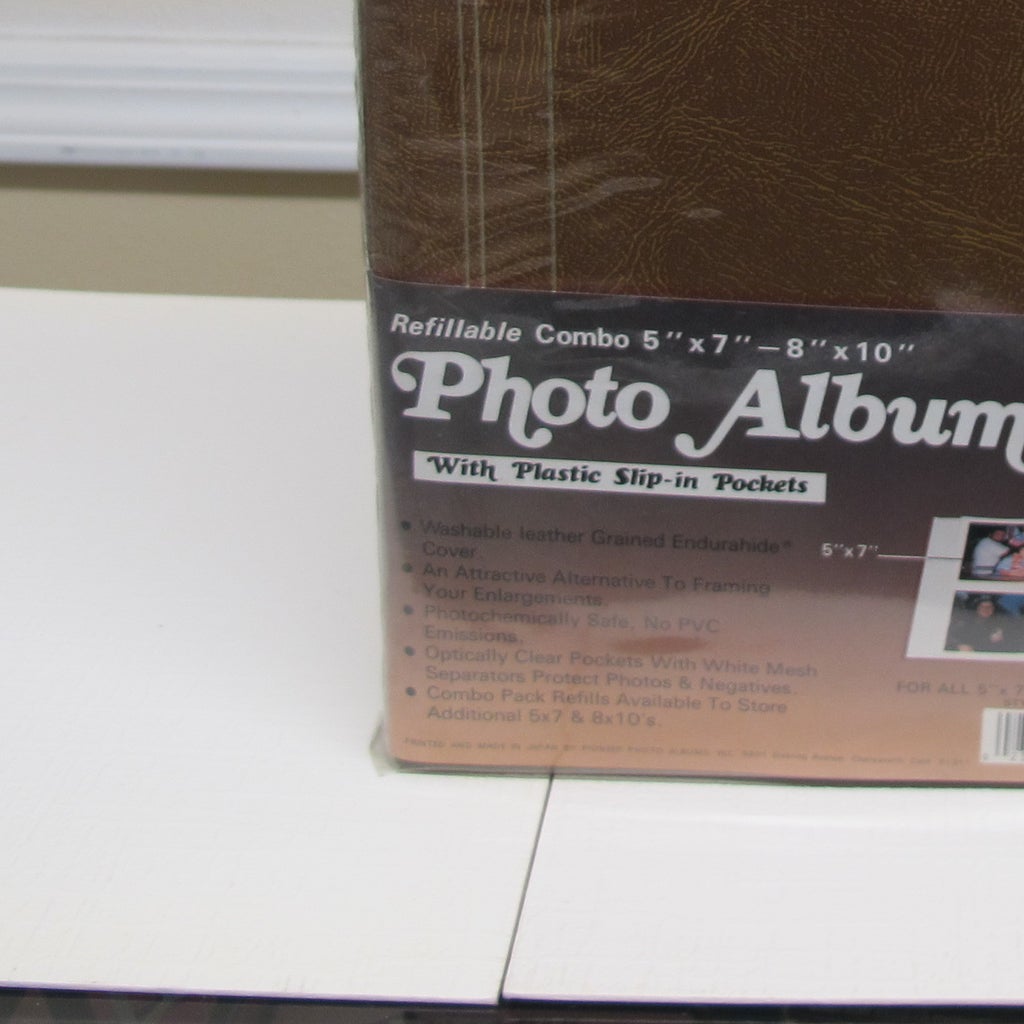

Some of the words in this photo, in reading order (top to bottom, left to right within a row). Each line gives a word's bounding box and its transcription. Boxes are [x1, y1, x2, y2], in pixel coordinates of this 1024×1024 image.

[390, 313, 522, 342] Refillable
[536, 324, 630, 349] Combo
[391, 351, 671, 448] Photo
[427, 455, 498, 482] With
[512, 461, 602, 484] Plastic
[614, 467, 698, 490] Slip-in
[712, 472, 808, 494] Pockets
[420, 519, 513, 540] Washable
[520, 525, 584, 543] leather
[591, 529, 665, 548] Grained
[422, 562, 449, 578] An
[455, 564, 547, 583] Attractive
[552, 569, 656, 589] Alternative
[662, 575, 686, 591] To
[693, 577, 770, 598] Framing
[423, 583, 467, 600] Your
[424, 604, 580, 627] Photochemically
[587, 613, 634, 632] Safe,
[644, 617, 671, 632] No
[679, 618, 721, 633] PVC
[424, 624, 523, 644] Emissions.
[425, 644, 508, 665] Optically
[515, 648, 562, 664] Clear
[570, 651, 643, 668] Pockets
[651, 655, 696, 671] With
[703, 658, 760, 675] White
[766, 662, 818, 678] Mesh
[425, 665, 526, 684] Separators
[532, 669, 599, 686] Protect
[606, 672, 672, 689] Photos
[679, 676, 692, 690] &
[700, 677, 798, 696] Negatives.
[896, 680, 931, 694] FOR
[937, 682, 969, 695] ALL
[427, 685, 494, 702] Combo
[502, 688, 545, 703] Pack
[553, 689, 610, 706] Refills
[616, 692, 702, 711] Available
[709, 696, 731, 712] To
[738, 697, 788, 714] Store
[427, 705, 522, 722] Additional
[529, 709, 563, 724] 5x7
[571, 710, 584, 724] &
